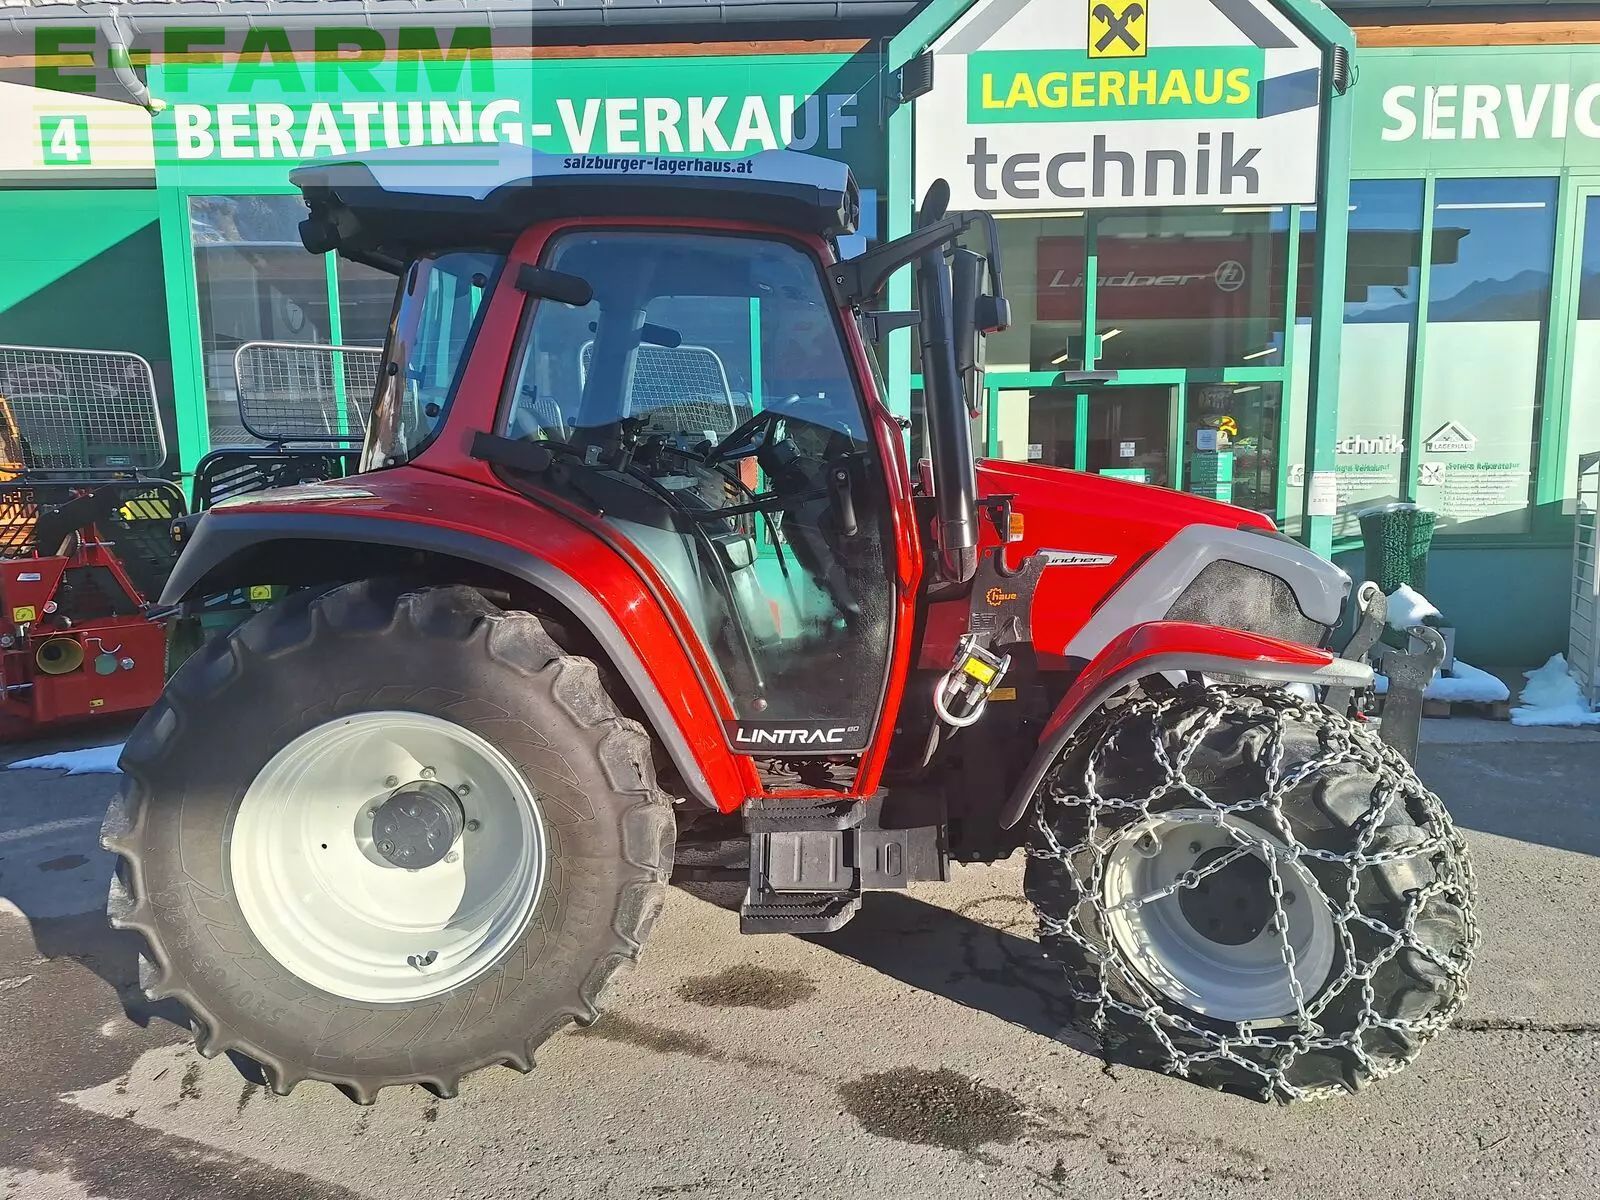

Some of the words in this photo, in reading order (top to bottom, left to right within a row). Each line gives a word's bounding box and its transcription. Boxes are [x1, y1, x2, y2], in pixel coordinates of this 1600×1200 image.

[982, 68, 1251, 109] LAGERHAUS
[50, 118, 82, 162] 4
[563, 156, 753, 174] salzburger-lagerhaus.at
[966, 132, 1262, 200] technik
[1047, 556, 1103, 564] indner
[735, 728, 846, 744] LINTRAC
